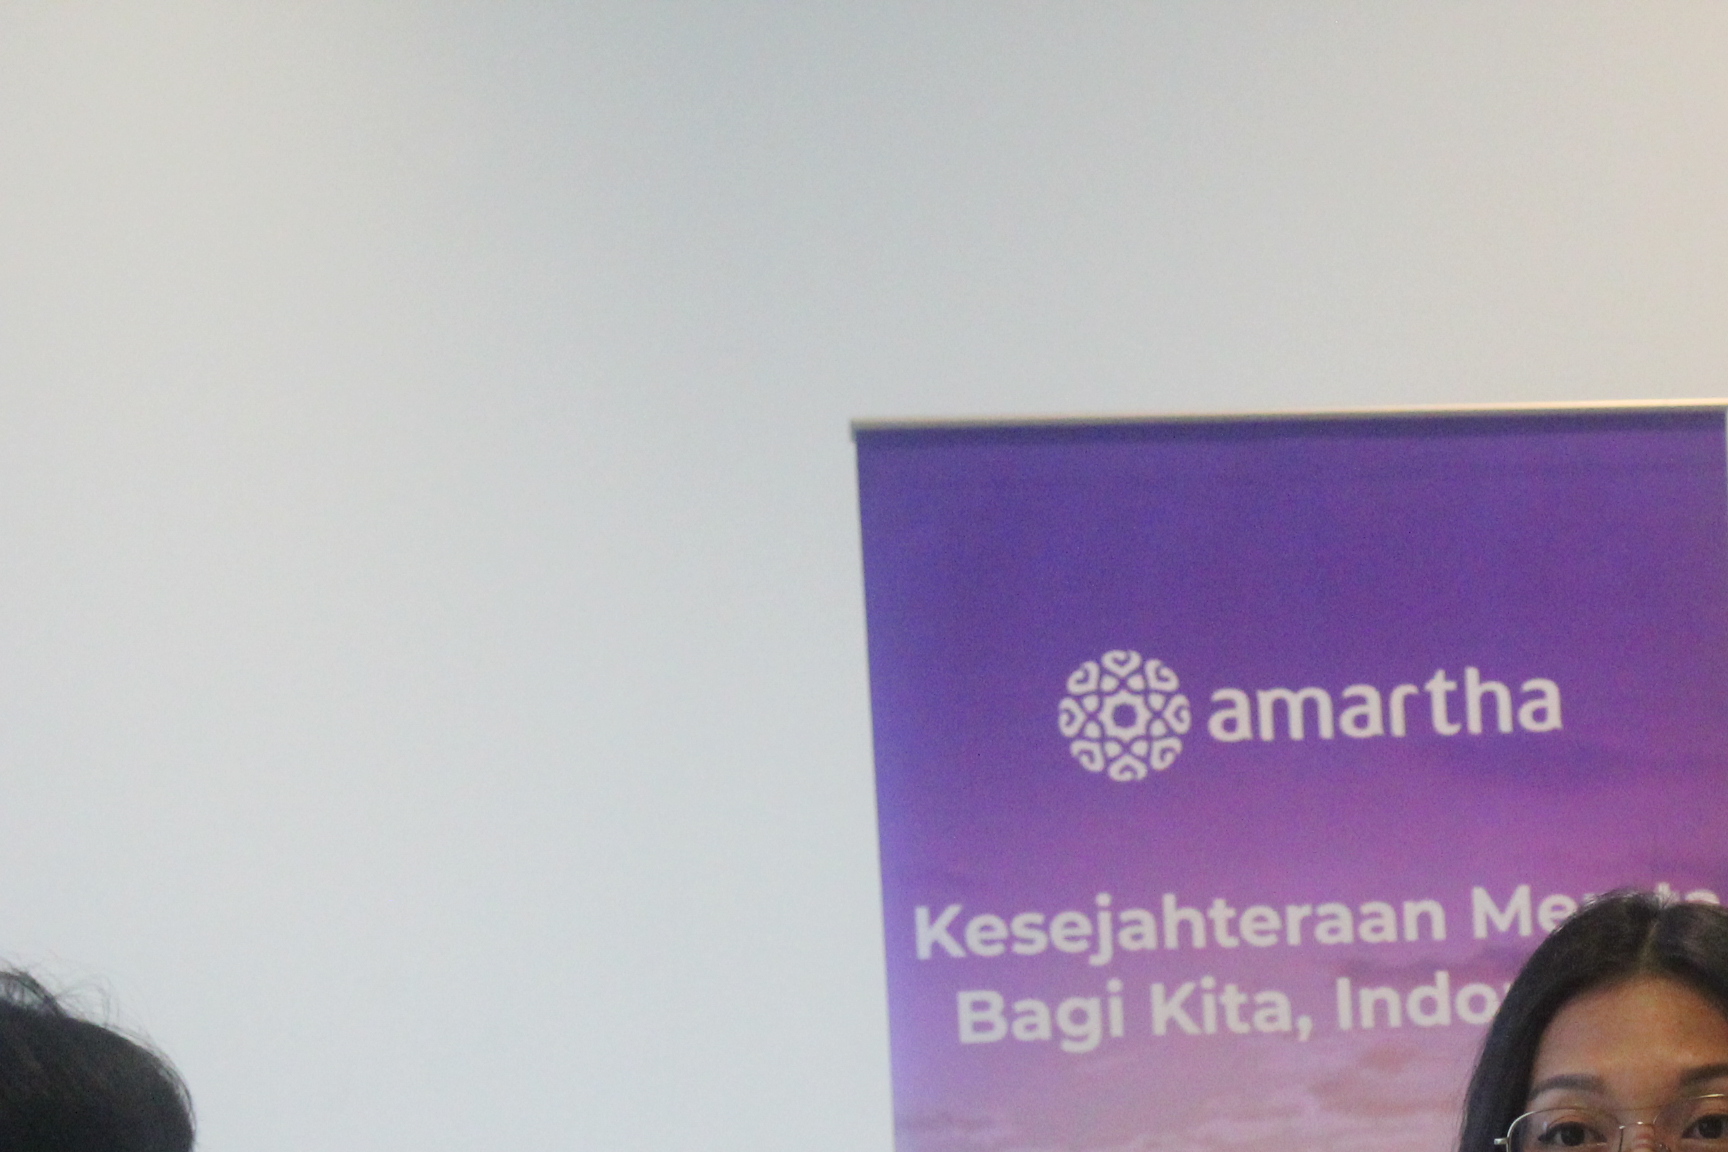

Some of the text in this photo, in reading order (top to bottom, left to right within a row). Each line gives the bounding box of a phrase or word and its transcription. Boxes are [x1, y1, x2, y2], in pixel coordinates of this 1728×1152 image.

[1207, 666, 1564, 743] amartha
[914, 892, 1447, 966] Kesejahteraan
[956, 970, 1512, 1053] Bagi Kita, Indo
